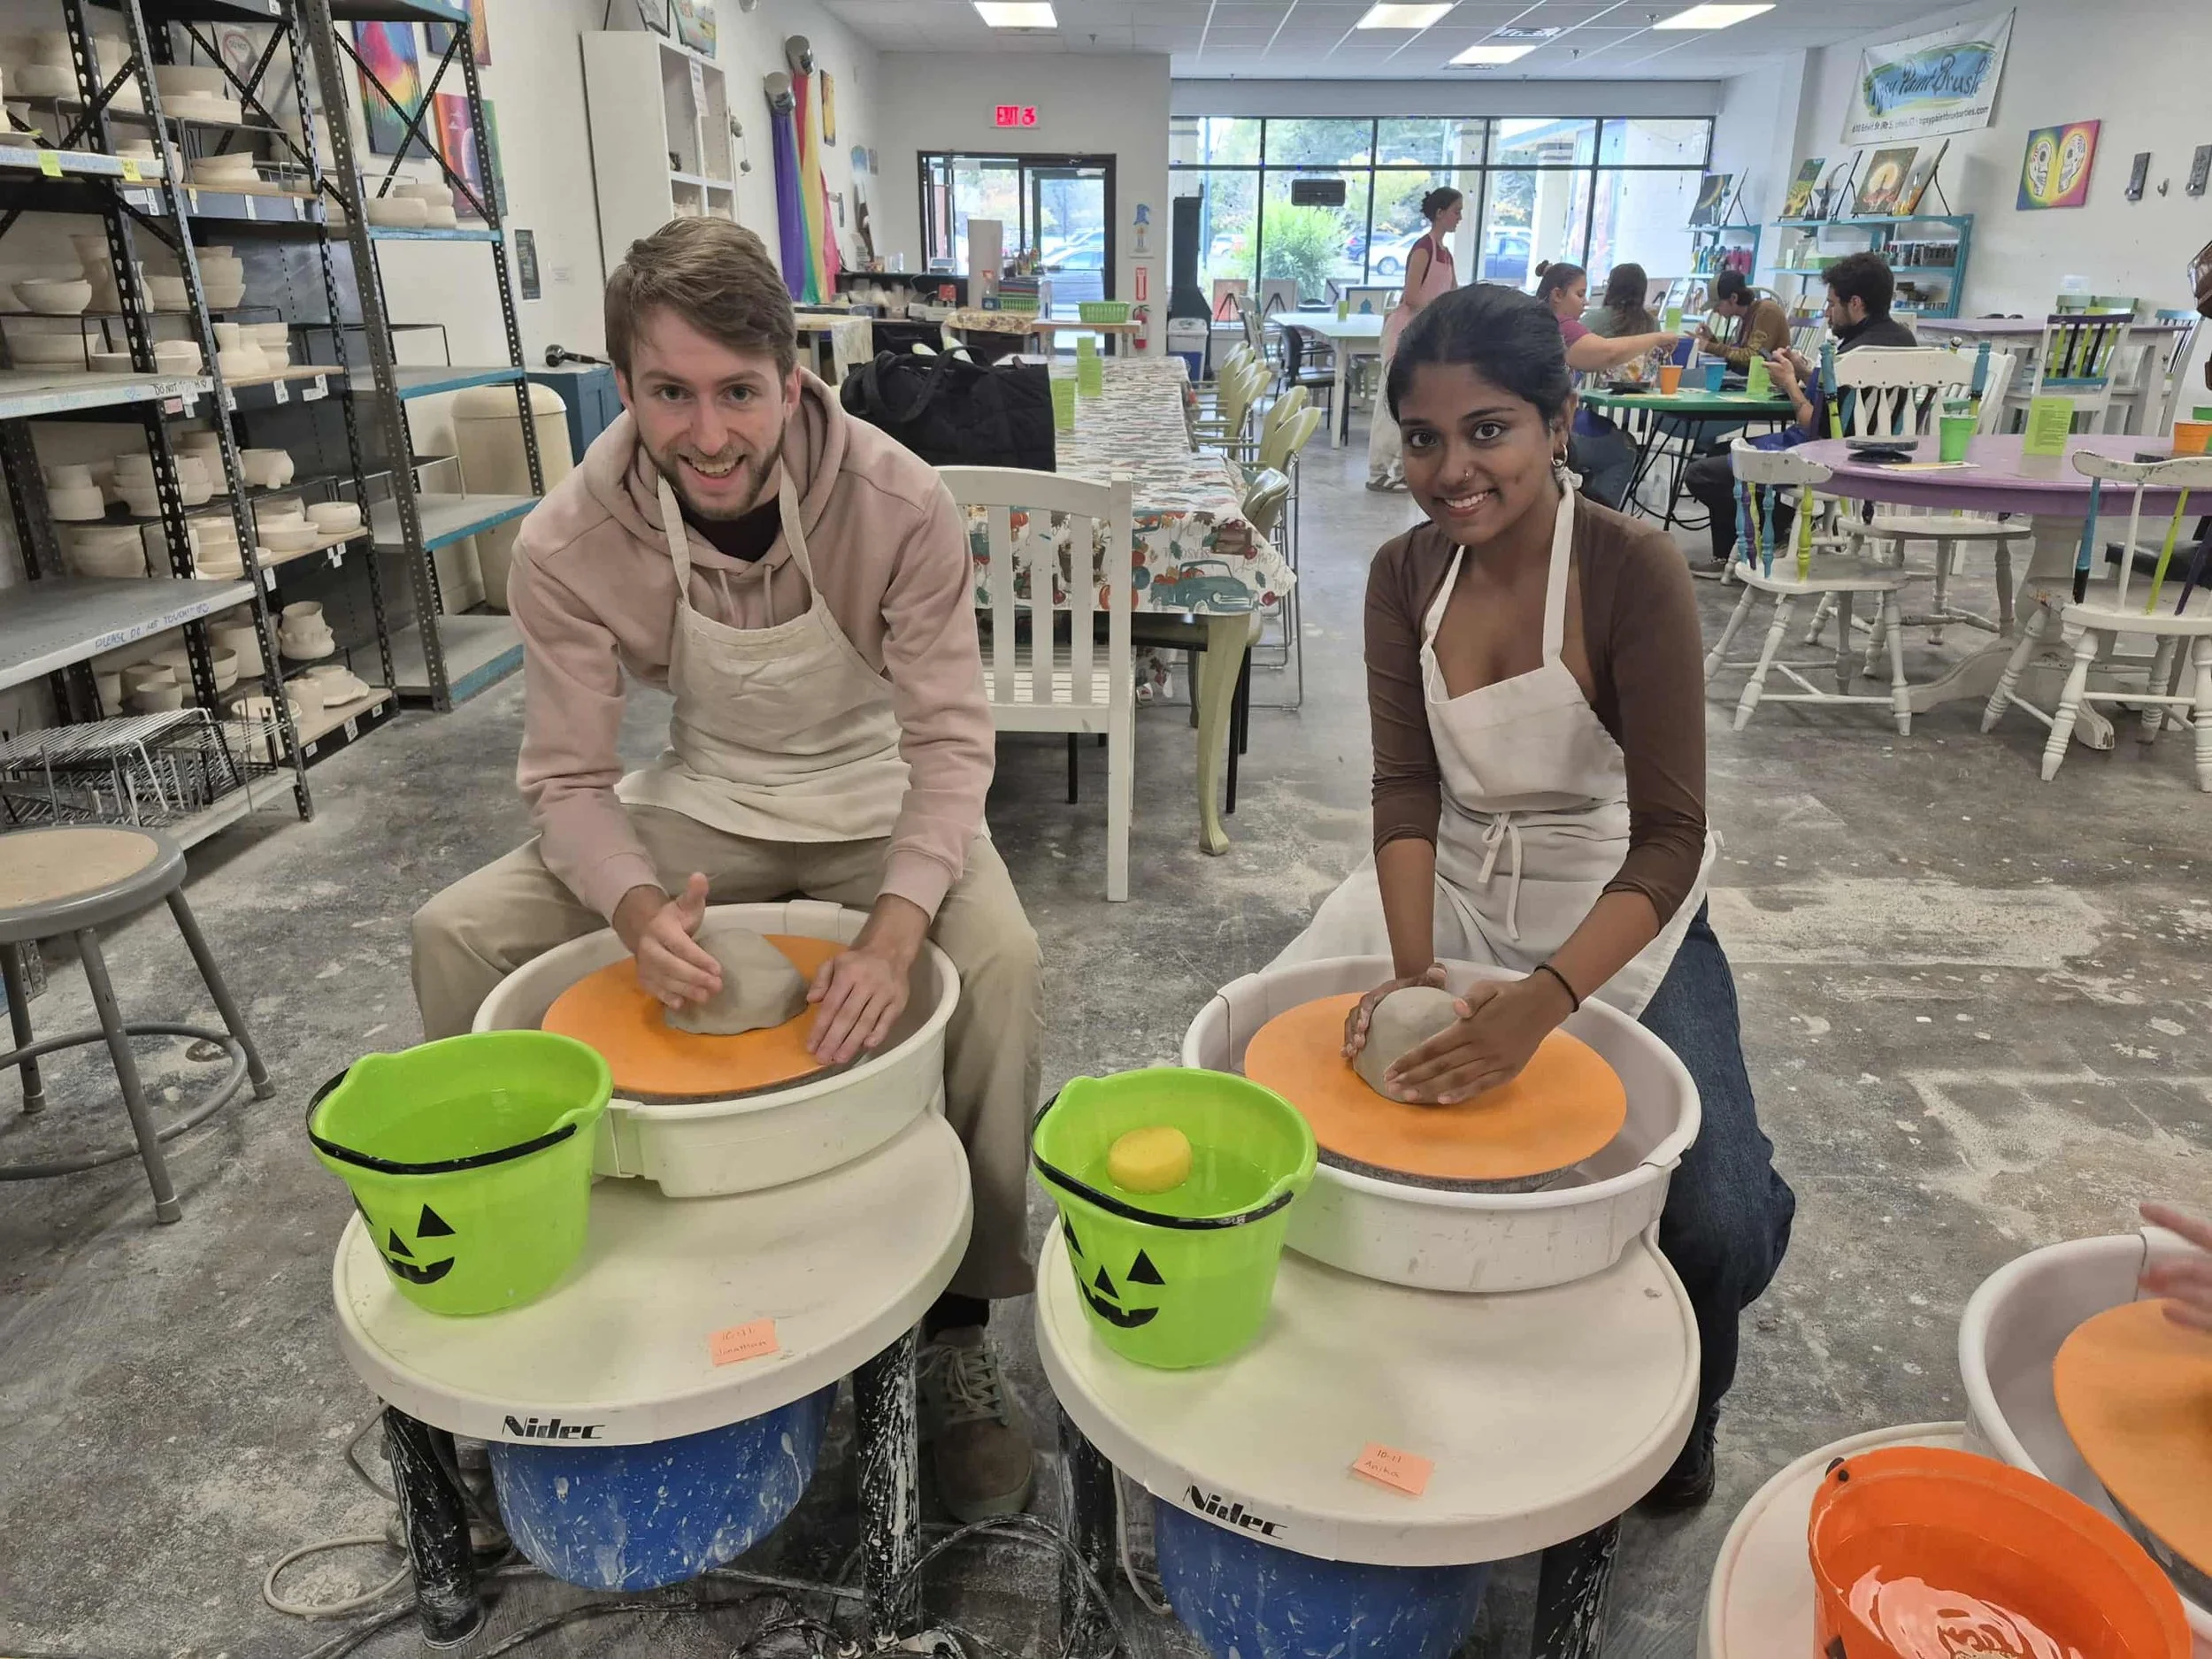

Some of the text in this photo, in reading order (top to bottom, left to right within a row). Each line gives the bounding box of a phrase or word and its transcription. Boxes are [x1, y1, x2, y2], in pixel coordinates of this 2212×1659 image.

[155, 384, 165, 396] DO
[165, 383, 177, 394] NOT
[95, 632, 126, 649] PLEASE
[130, 626, 141, 639] DO
[502, 1416, 606, 1440] Nidec
[1182, 1485, 1288, 1540] Nidec
